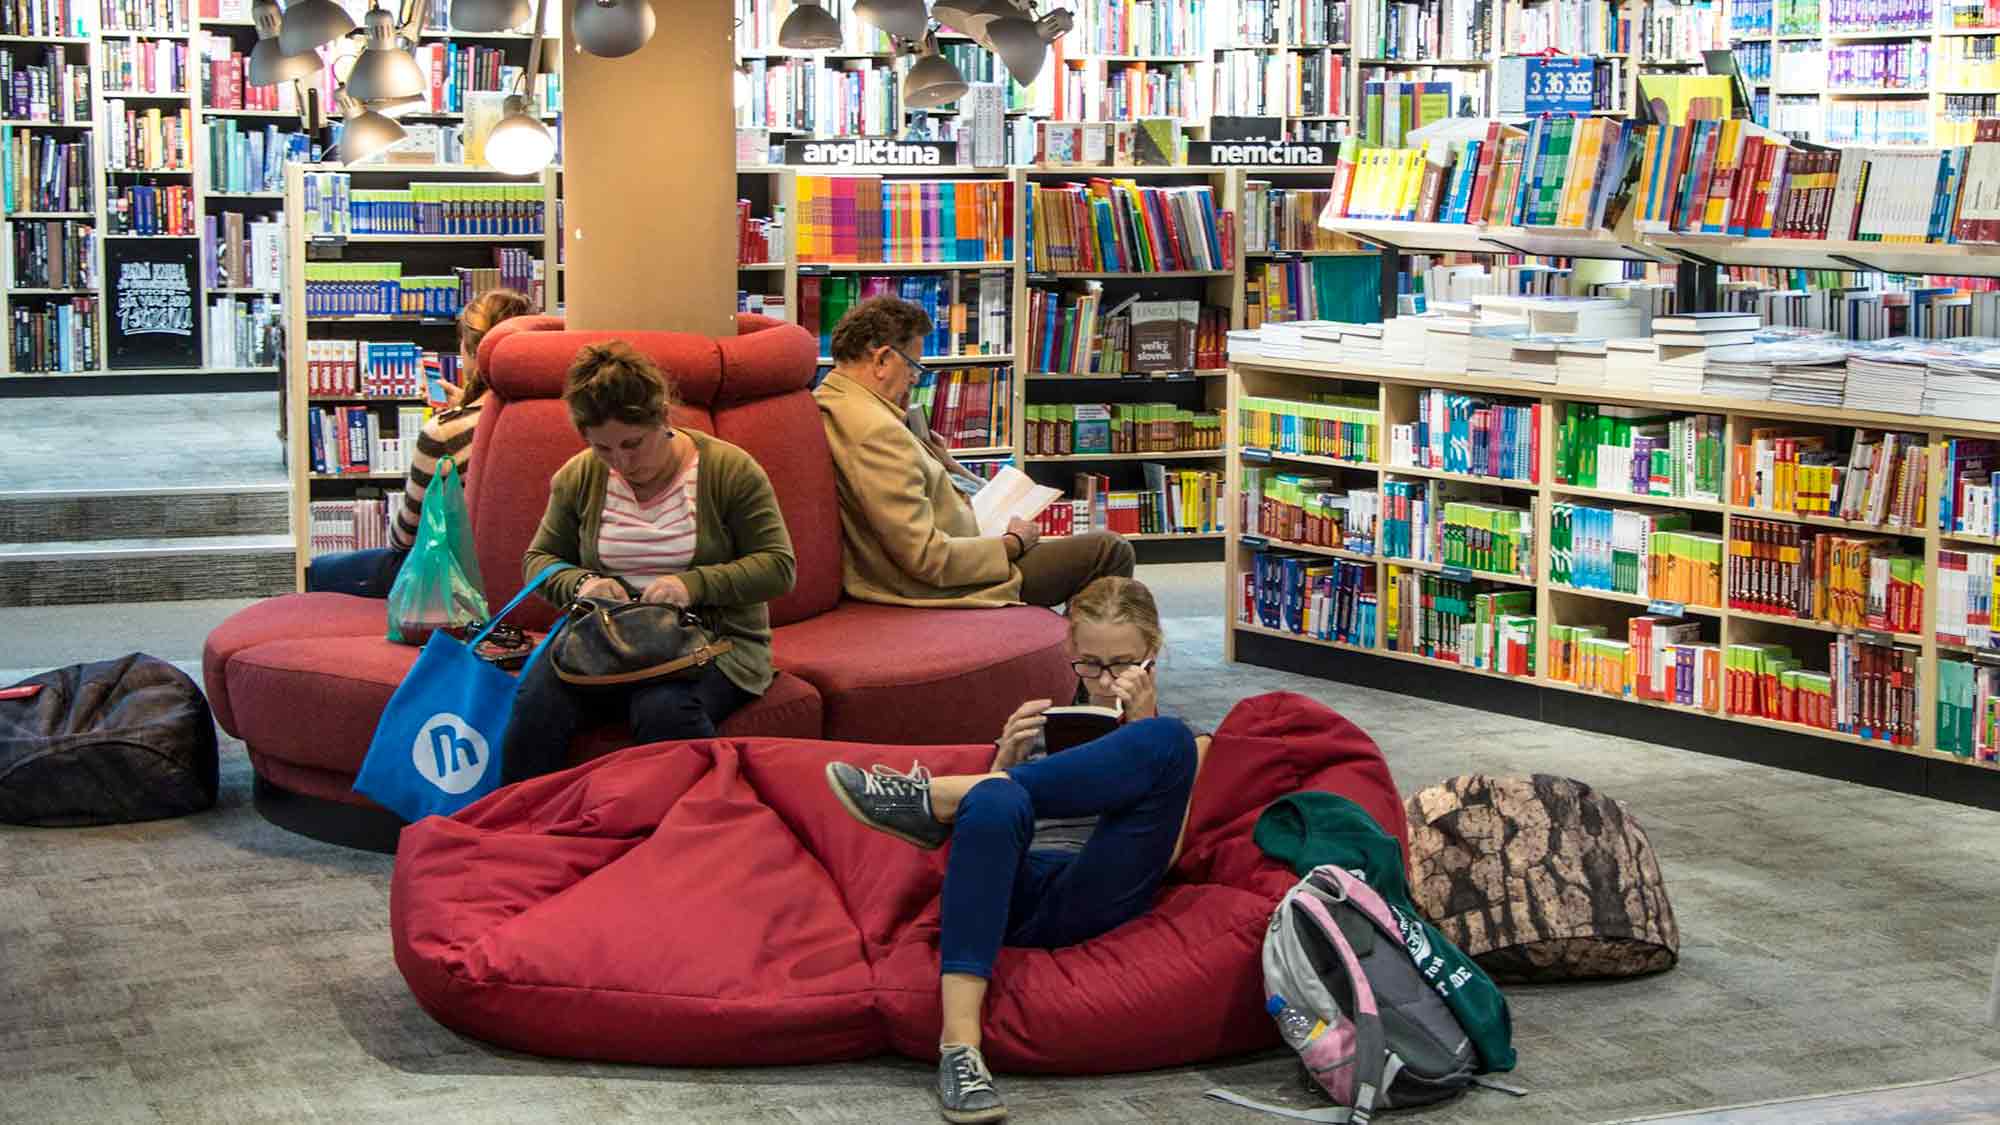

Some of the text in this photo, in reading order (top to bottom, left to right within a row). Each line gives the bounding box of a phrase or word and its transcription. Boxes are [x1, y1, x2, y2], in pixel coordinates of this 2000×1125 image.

[1531, 71, 1593, 94] 3 36 365
[803, 139, 940, 166] angličtina
[1210, 140, 1323, 164] nemčina
